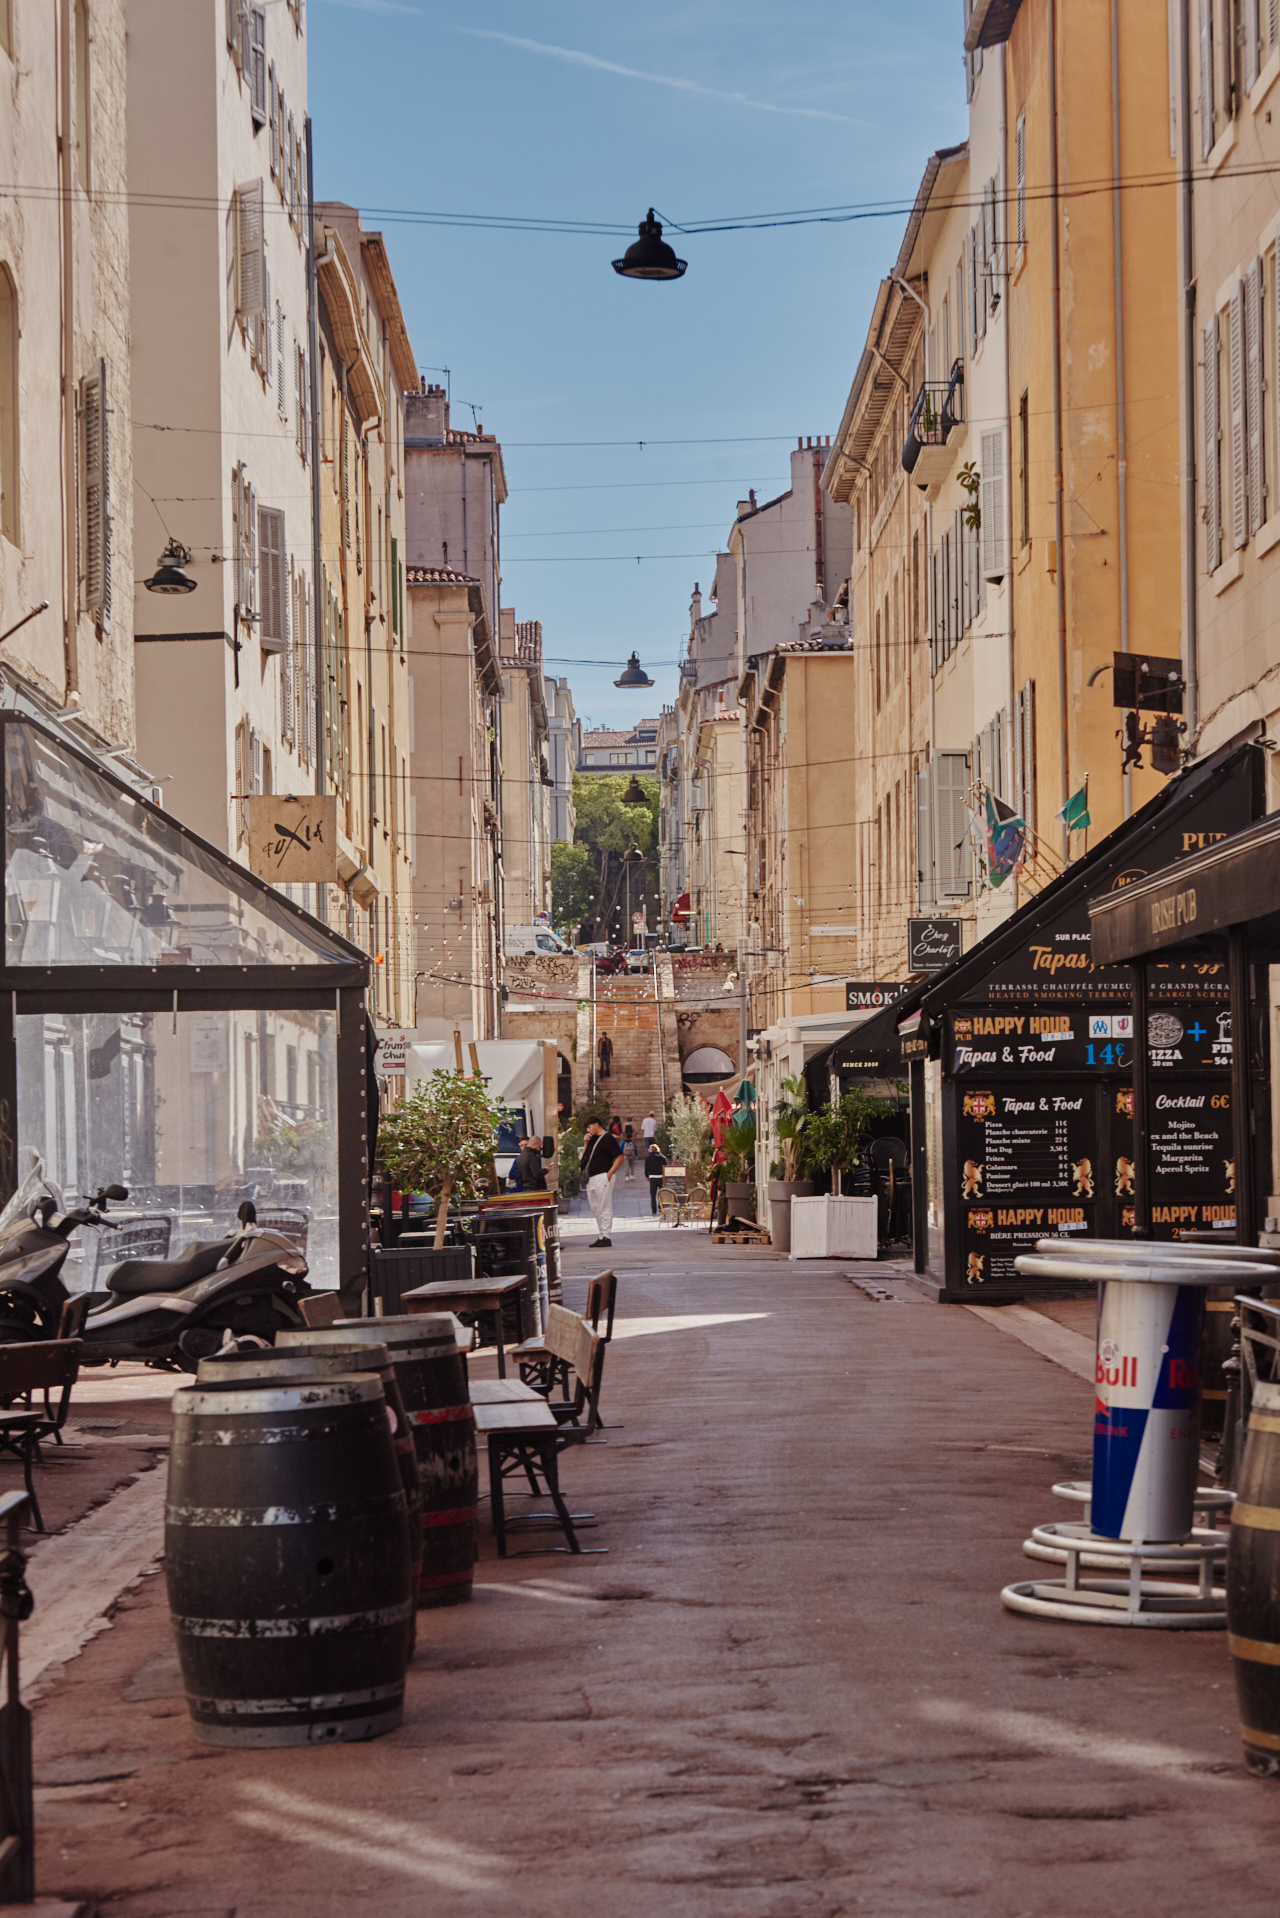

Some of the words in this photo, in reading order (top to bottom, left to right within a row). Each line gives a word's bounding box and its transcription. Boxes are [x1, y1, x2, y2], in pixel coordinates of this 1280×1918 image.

[1152, 896, 1175, 934] IRISH
[1176, 888, 1197, 926] PUB
[921, 927, 949, 941] Chez
[913, 942, 957, 958] Charlot
[1029, 946, 1095, 975] Tapas,
[1042, 982, 1093, 990] CHAUFFÉE
[974, 1017, 1025, 1035] HAPPY
[1030, 1016, 1070, 1034] HOUR
[956, 1046, 997, 1067] Tapas
[1002, 1046, 1013, 1062] &
[1018, 1045, 1056, 1063] Food
[1149, 1049, 1183, 1060] IZZA
[1214, 1057, 1228, 1065] 56
[1002, 1097, 1035, 1115] Tapas
[1039, 1097, 1049, 1111] &
[1052, 1096, 1083, 1111] Food
[1156, 1094, 1205, 1110] Cocktail
[1211, 1095, 1230, 1108] 6€
[1168, 1121, 1195, 1130] Mojito
[1162, 1132, 1177, 1140] and
[999, 1146, 1012, 1154] Dog
[1151, 1143, 1181, 1152] Tequila
[1162, 1154, 1203, 1163] Margarita
[1156, 1165, 1183, 1174] Aperol
[1184, 1165, 1209, 1174] Spritz
[1012, 1181, 1029, 1189] glacé
[998, 1209, 1044, 1225] HAPPY
[1048, 1208, 1084, 1224] HOUR
[1152, 1206, 1198, 1222] HAPPY
[1202, 1205, 1236, 1221] HOUR
[990, 1231, 1012, 1239] BIÈRE
